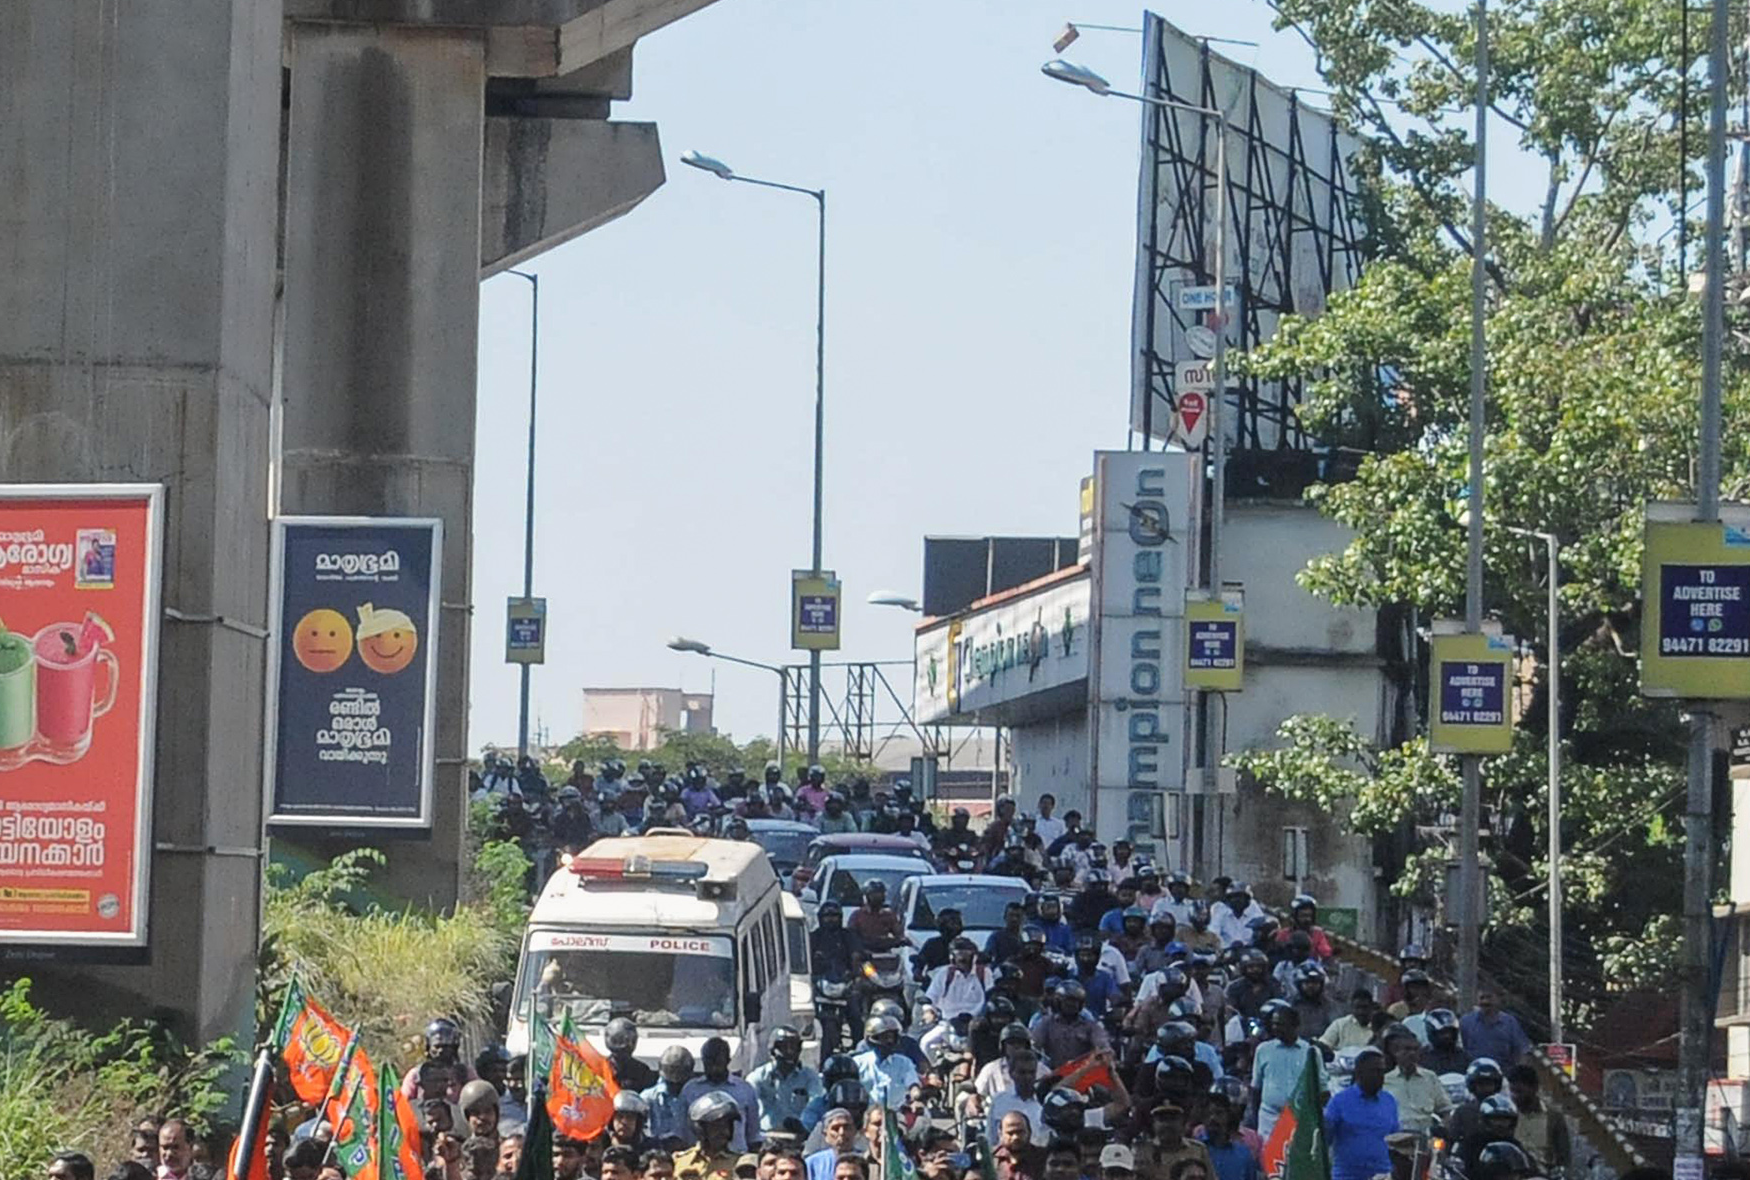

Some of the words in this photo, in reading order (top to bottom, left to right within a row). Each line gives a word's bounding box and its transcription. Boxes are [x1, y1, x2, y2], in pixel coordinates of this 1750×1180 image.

[315, 550, 400, 574] മാതൃഭൂമി
[1699, 570, 1715, 584] TO
[1673, 586, 1740, 600] ADVERTISE
[1690, 603, 1724, 617] HERE
[316, 728, 392, 748] മാതൃഭൂമി
[650, 940, 710, 951] POLICE
